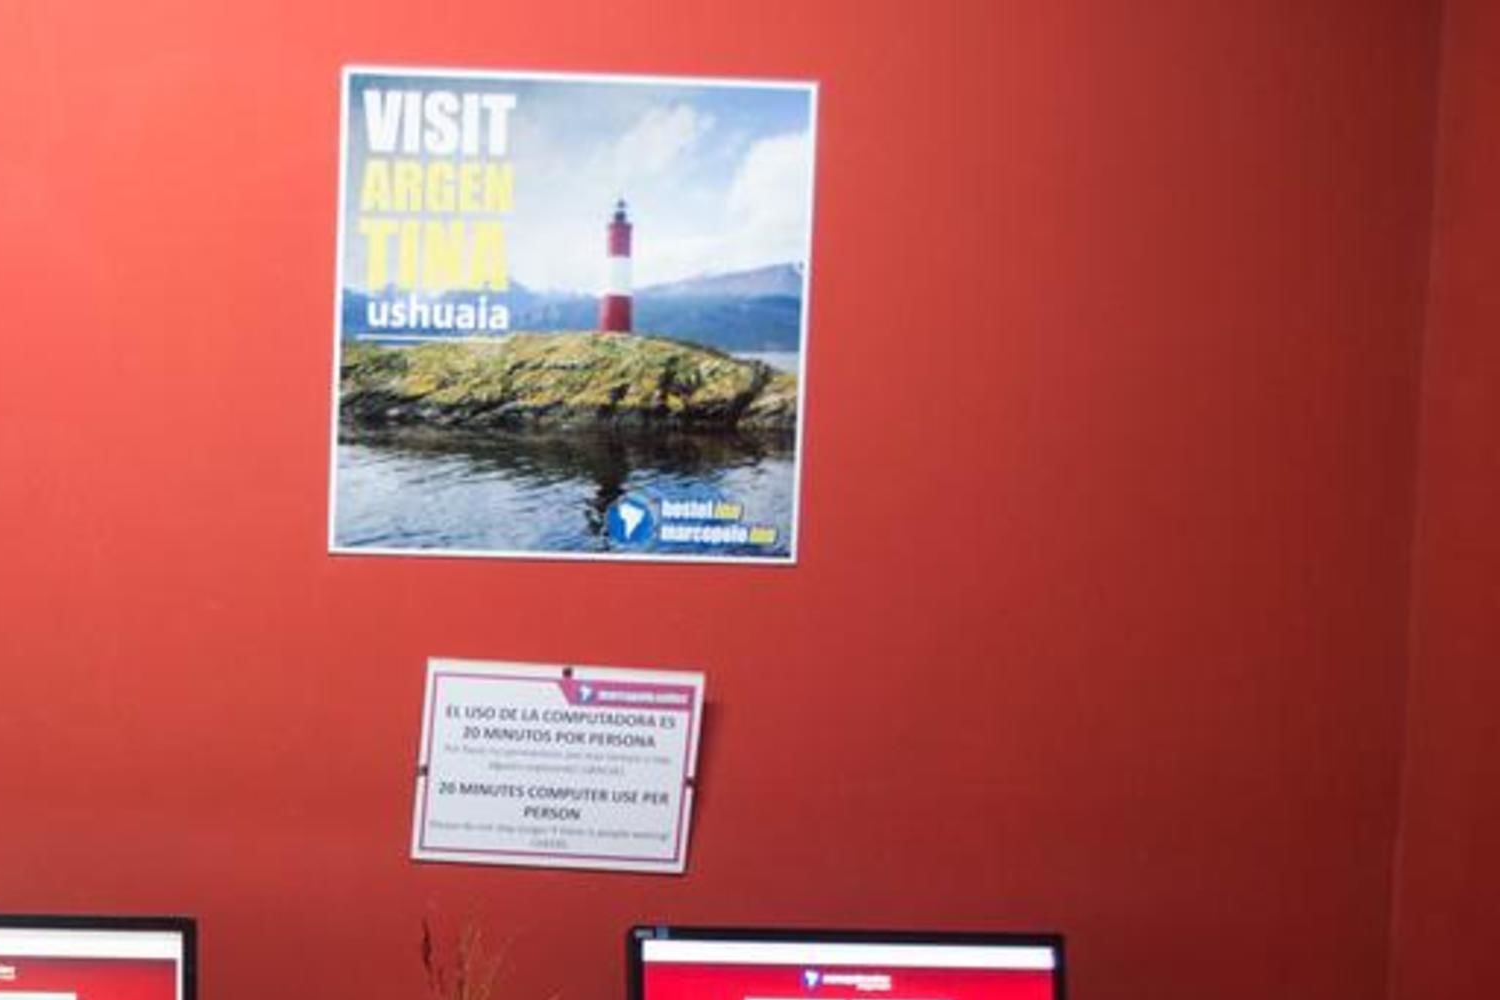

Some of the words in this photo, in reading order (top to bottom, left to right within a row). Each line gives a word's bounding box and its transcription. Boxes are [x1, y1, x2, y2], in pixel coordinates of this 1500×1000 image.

[362, 89, 516, 155] VISIT
[360, 158, 515, 212] ARGEN
[359, 218, 510, 292] TINA
[367, 293, 510, 329] ushuaia
[445, 706, 460, 718] EL
[464, 707, 495, 720] USO
[498, 708, 517, 721] DE
[521, 709, 539, 721] LA
[543, 710, 656, 728] COMPUTADORA
[660, 715, 676, 728] ES
[463, 726, 481, 739] 20
[484, 728, 552, 743] MINUTOS
[555, 731, 585, 745] POR
[589, 732, 656, 748] PERSONA
[438, 781, 457, 795] 20
[460, 783, 524, 798] MINUTES
[528, 785, 607, 802] COMPUTER
[612, 789, 638, 803] USE
[642, 791, 669, 805] PER
[524, 806, 582, 821] PERSON
